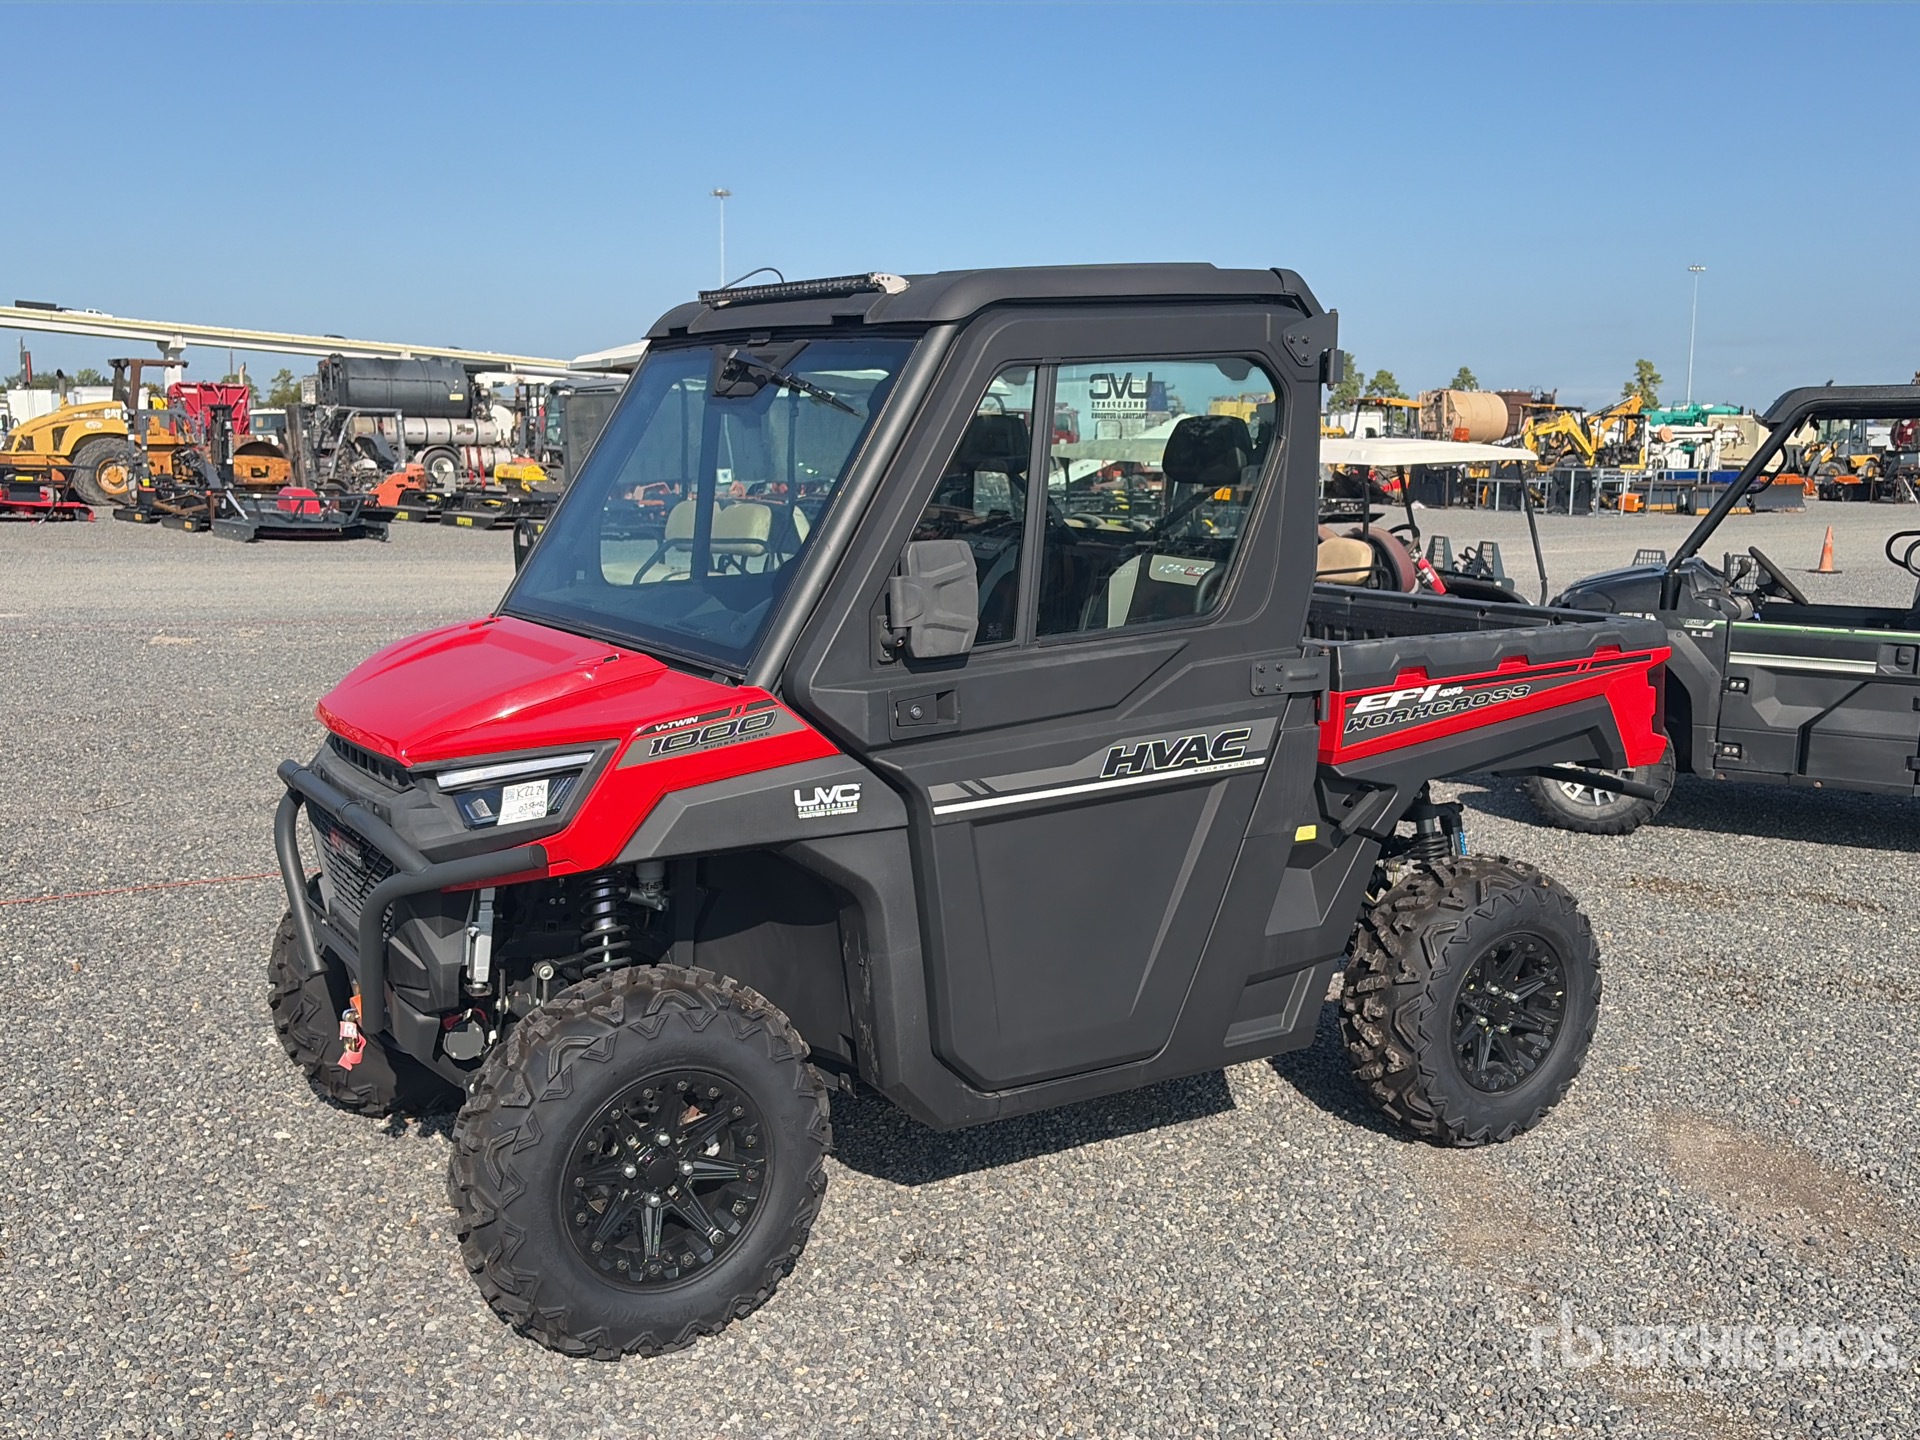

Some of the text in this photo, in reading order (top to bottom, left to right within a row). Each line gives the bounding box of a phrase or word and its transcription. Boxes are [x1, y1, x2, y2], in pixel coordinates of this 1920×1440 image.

[104, 408, 122, 420] CAT
[1343, 684, 1531, 734] WORKCROSS
[1352, 684, 1441, 715] EFI
[648, 710, 778, 757] 1000
[655, 716, 698, 731] V-TWIN
[1099, 728, 1252, 778] HVAC
[794, 783, 861, 807] UVC
